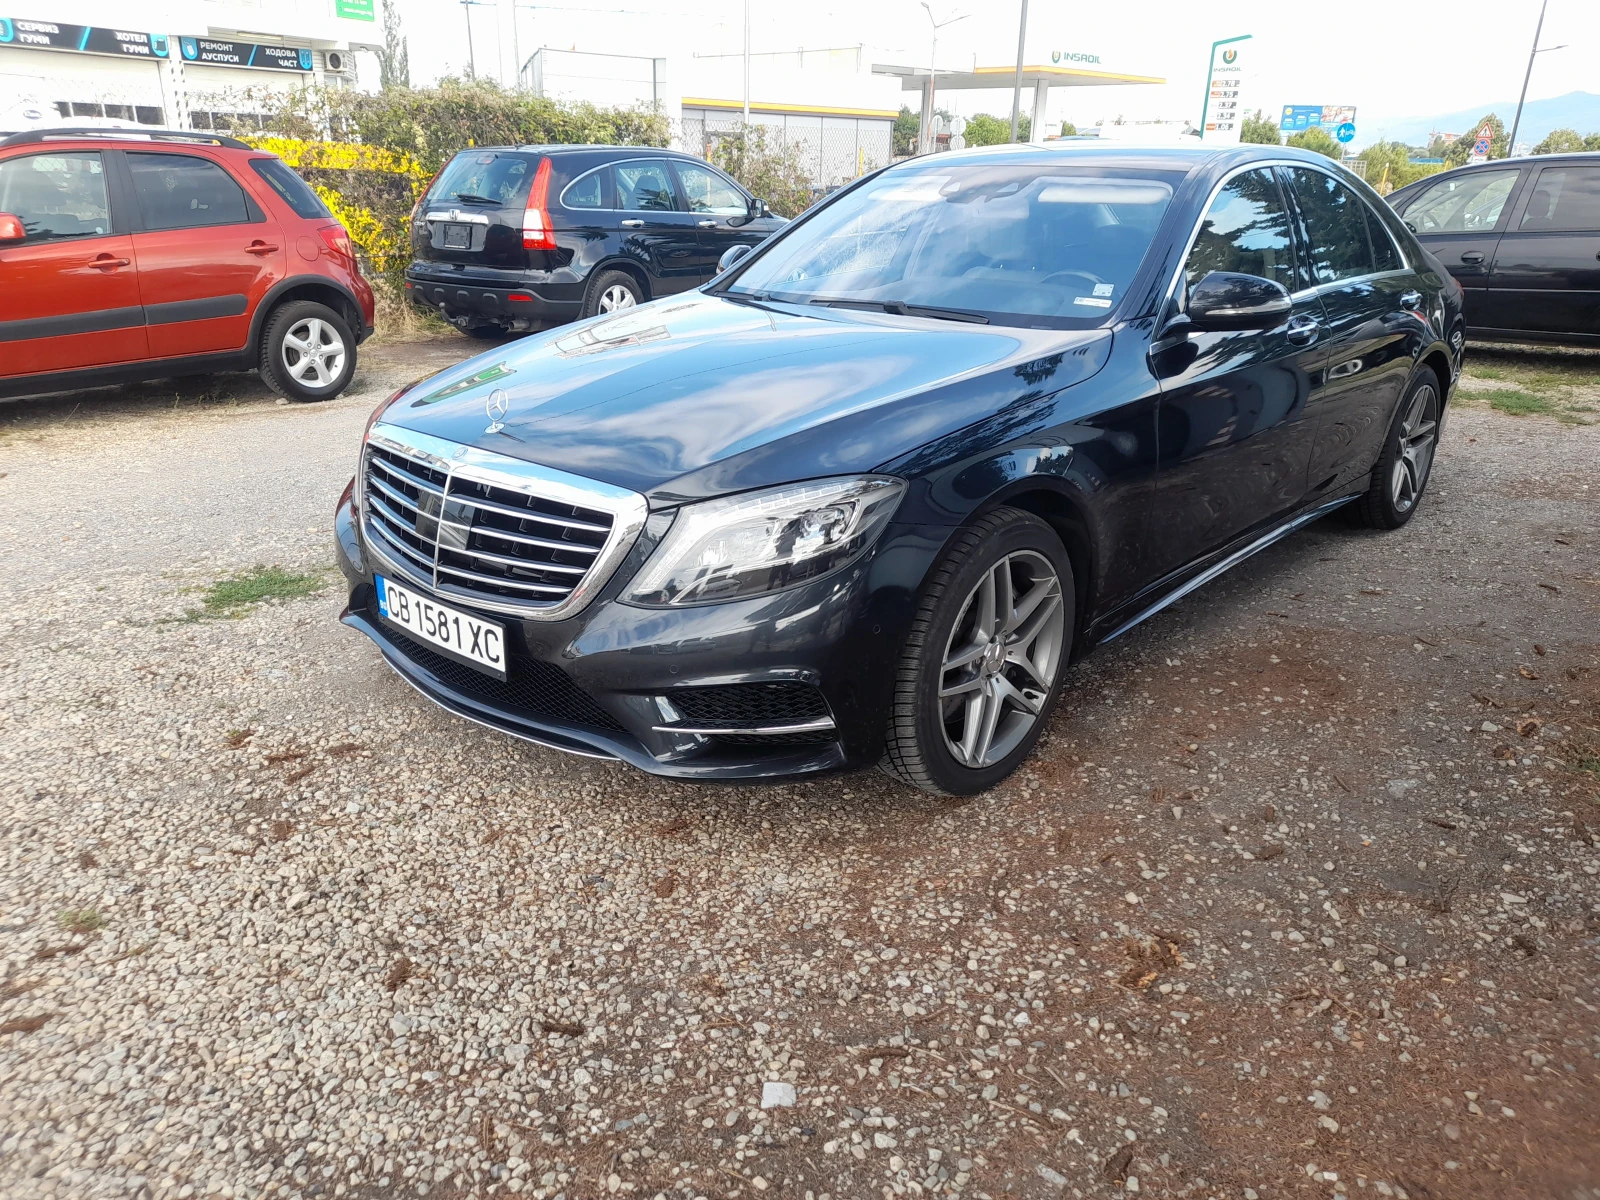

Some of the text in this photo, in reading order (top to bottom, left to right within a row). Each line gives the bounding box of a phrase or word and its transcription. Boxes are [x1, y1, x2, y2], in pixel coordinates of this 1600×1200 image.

[17, 21, 59, 34] СЕРВИЗ
[19, 33, 50, 45] ГУМИ
[115, 31, 148, 43] ХОТЕЛ
[122, 43, 150, 54] ГУМИ
[199, 41, 233, 52] РЕМОНТ
[201, 52, 239, 63] АУСПУСИ
[265, 48, 297, 58] ХОДОВА
[1063, 51, 1102, 65] INSAOIL
[278, 59, 297, 68] ЧАСТ
[387, 586, 500, 663] CB 1581 XC
